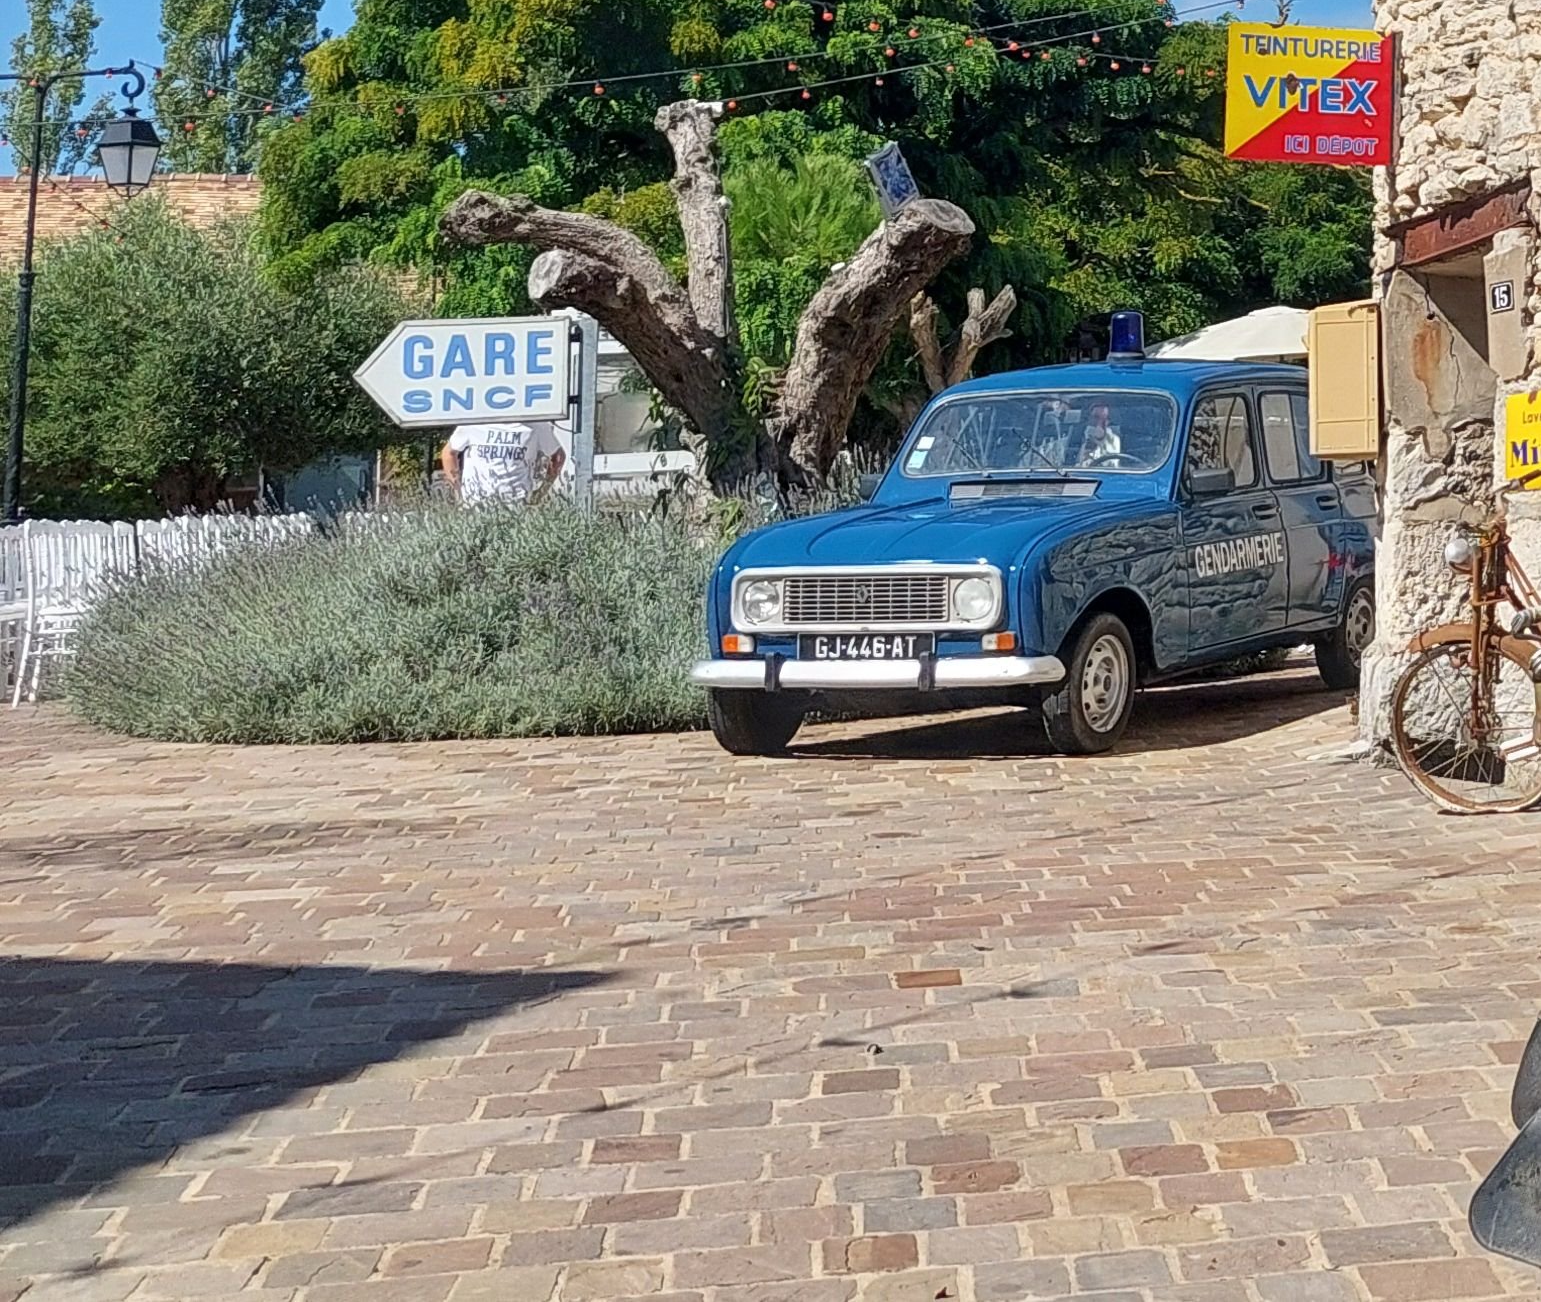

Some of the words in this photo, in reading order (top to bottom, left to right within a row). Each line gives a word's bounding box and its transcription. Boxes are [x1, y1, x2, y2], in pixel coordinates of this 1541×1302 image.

[1240, 33, 1381, 63] TEINTURERIE
[1243, 74, 1378, 115] VITEX
[1284, 134, 1310, 153] ICI
[1494, 286, 1508, 309] 15
[403, 330, 554, 379] GARE
[402, 384, 553, 413] SNCF
[486, 430, 522, 445] PALM
[477, 444, 527, 460] SPRINGS
[1195, 532, 1285, 578] GENDARMERIE
[815, 636, 917, 658] GJ-446-AT
